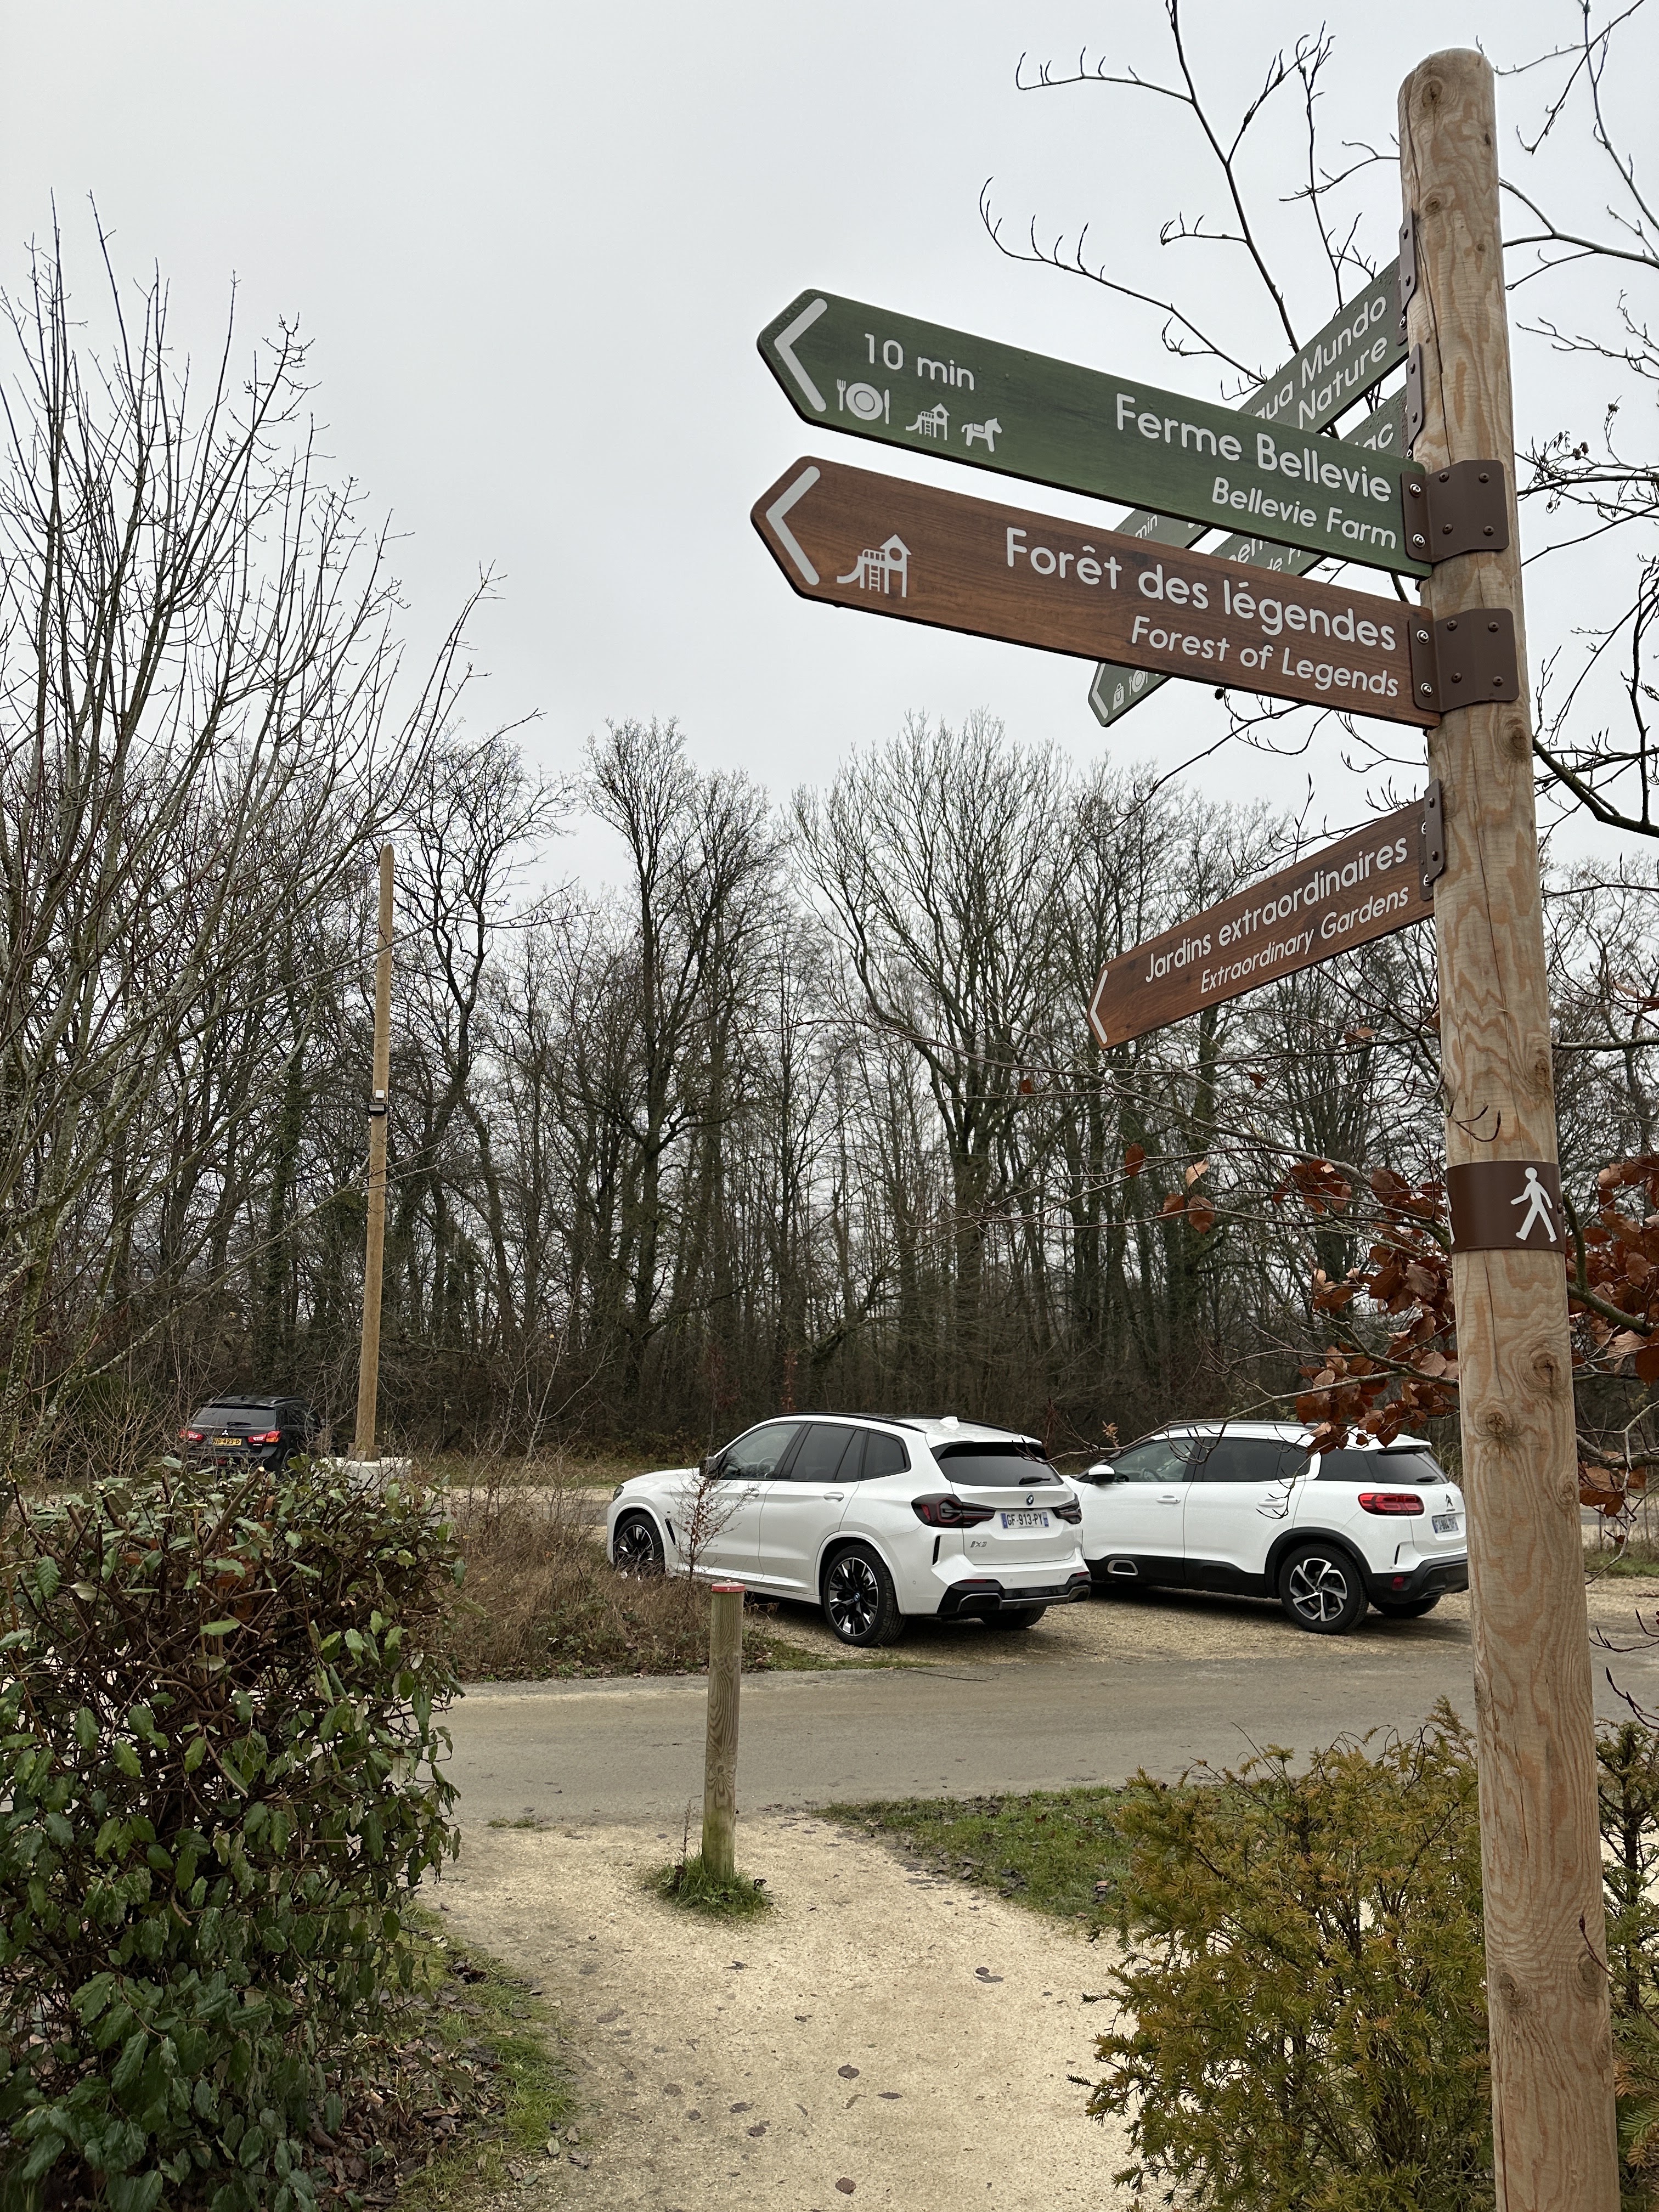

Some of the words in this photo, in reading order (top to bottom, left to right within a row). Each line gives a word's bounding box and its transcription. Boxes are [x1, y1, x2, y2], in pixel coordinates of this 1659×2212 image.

[865, 333, 904, 370] 10
[917, 357, 974, 391] min
[1299, 337, 1387, 430] Nature
[1301, 296, 1386, 388] Mundo
[1116, 393, 1242, 461] Ferme
[1257, 432, 1391, 502] Bellevie
[1135, 514, 1158, 538] min
[1212, 477, 1317, 527] Bellevie
[1327, 507, 1396, 549] Farm
[1007, 527, 1122, 590] Forêt
[1138, 564, 1209, 609] des
[1223, 579, 1396, 651] légendes
[1131, 616, 1230, 662] Forest
[1240, 645, 1274, 670] of
[1282, 647, 1398, 697] Legends
[1146, 934, 1211, 983] Jardins
[1218, 837, 1408, 946] extraordinaires
[1201, 928, 1314, 994] Extraordinary
[1321, 887, 1409, 939] Gardens
[1007, 1514, 1042, 1526] GF-913-PY
